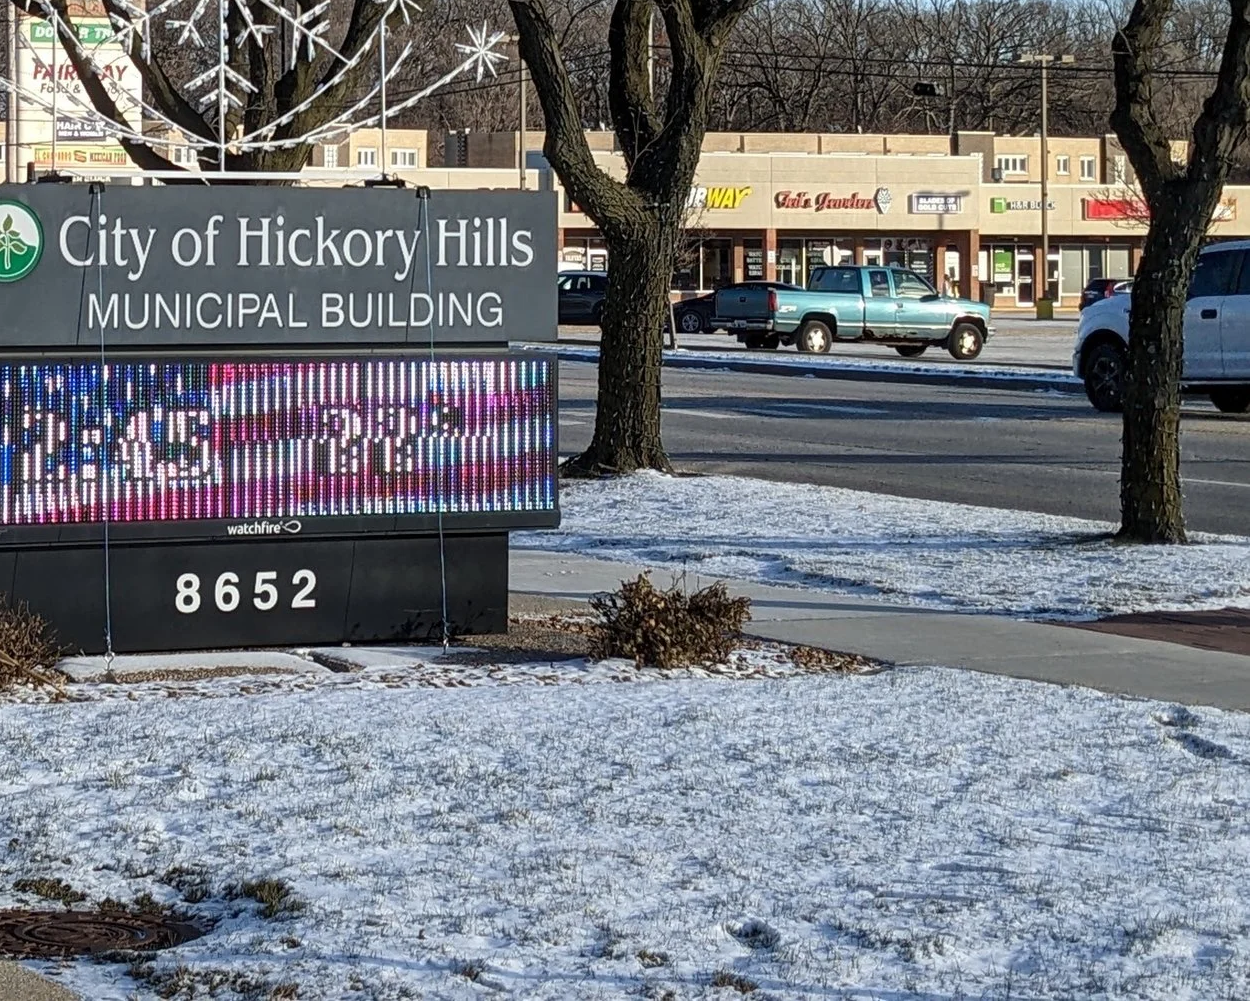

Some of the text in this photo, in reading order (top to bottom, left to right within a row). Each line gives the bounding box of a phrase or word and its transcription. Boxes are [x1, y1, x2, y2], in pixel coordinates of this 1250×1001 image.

[33, 63, 128, 81] FAIRAY
[684, 185, 753, 209] UBWAY
[59, 214, 535, 282] City of Hickory Hills
[88, 291, 504, 330] MUNICIPAL BUILDING
[227, 521, 282, 535] watchfire
[175, 569, 316, 614] 8652
